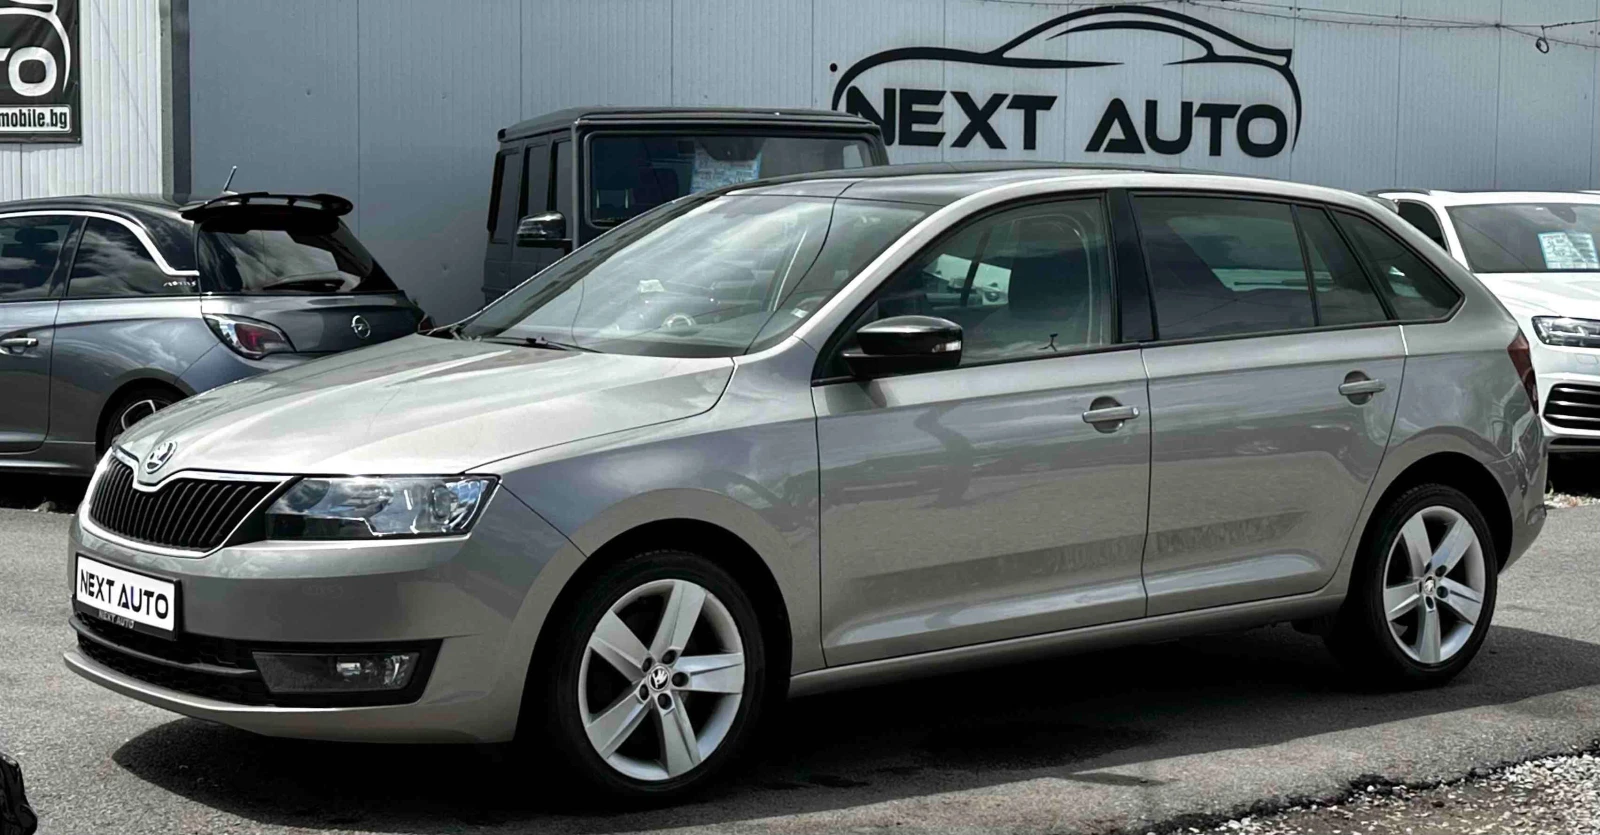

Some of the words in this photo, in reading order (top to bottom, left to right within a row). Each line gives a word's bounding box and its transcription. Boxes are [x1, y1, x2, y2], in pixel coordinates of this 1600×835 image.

[0, 46, 57, 97] O
[0, 108, 68, 129] mobile.bg
[846, 85, 1058, 150] NEXT
[1085, 97, 1288, 158] AUTO
[80, 569, 115, 604] NEXT
[117, 583, 169, 620] AUTO
[99, 610, 117, 624] NEXT
[116, 615, 135, 629] AUTO
